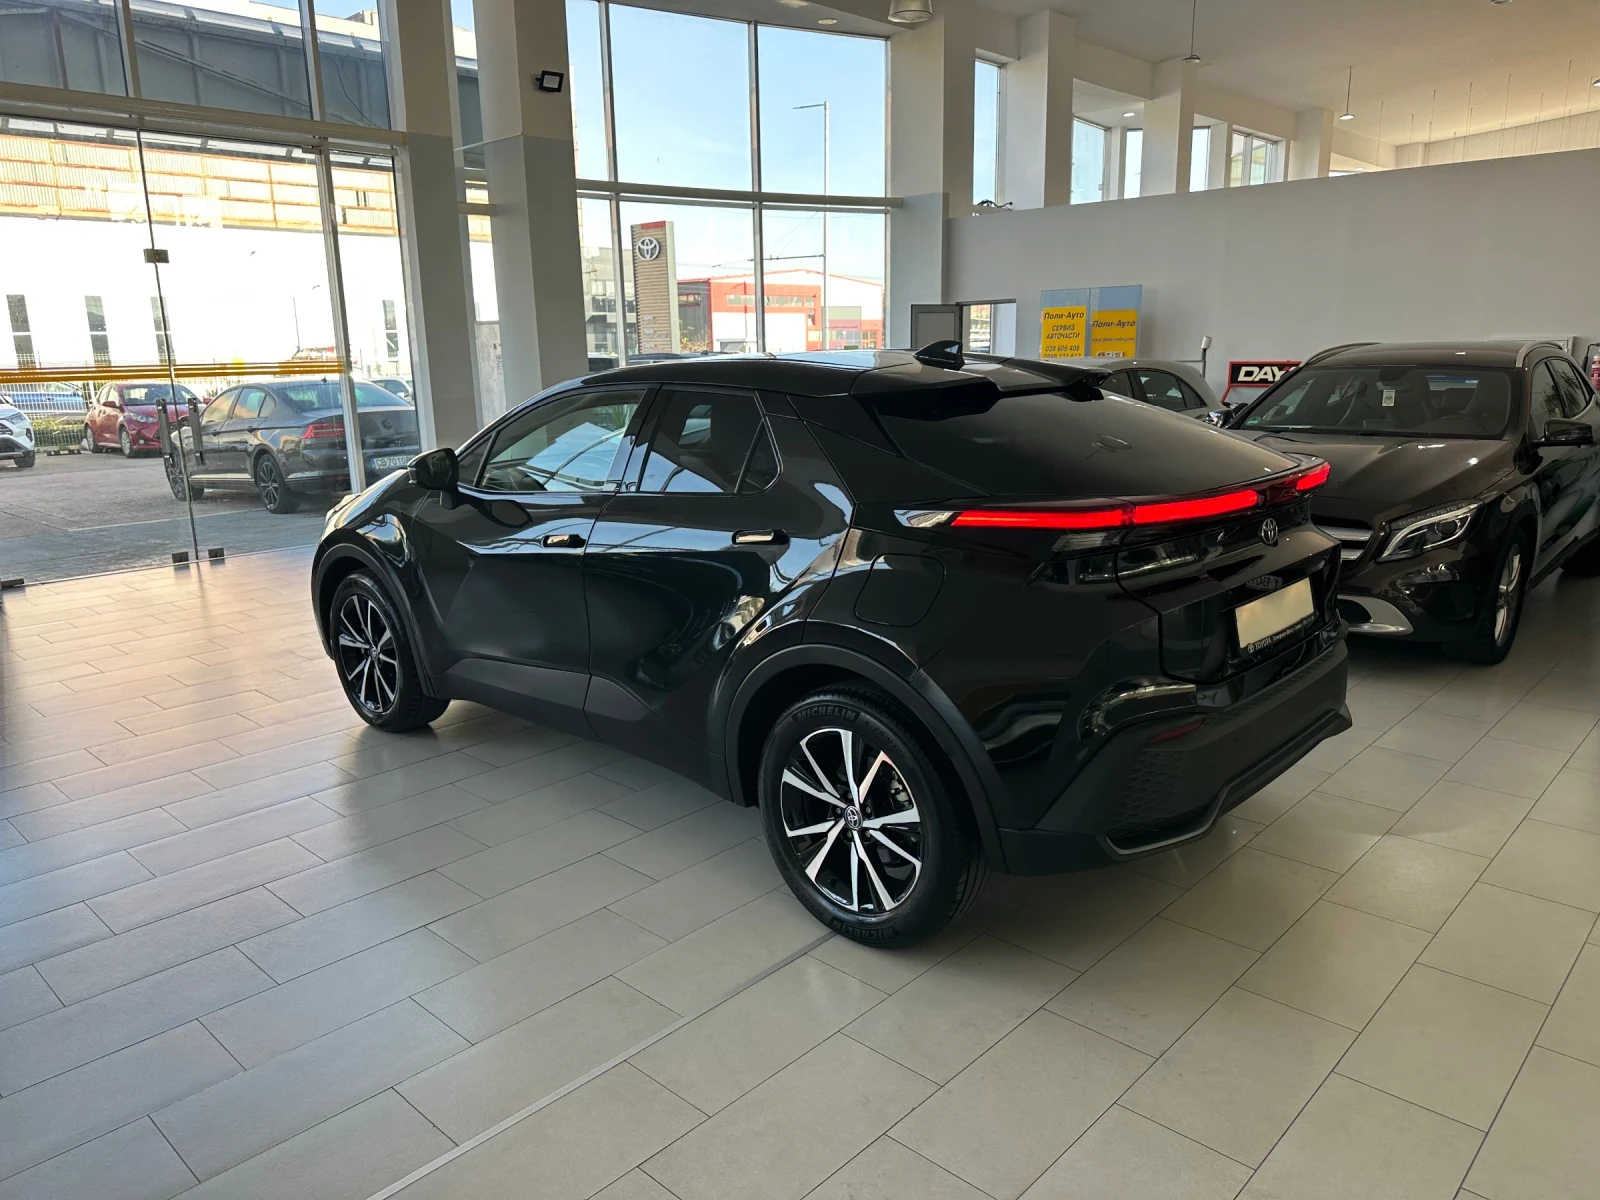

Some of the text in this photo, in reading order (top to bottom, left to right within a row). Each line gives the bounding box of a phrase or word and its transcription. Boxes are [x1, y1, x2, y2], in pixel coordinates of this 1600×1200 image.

[1044, 312, 1085, 320] Поли-Ауто
[1051, 324, 1075, 332] СЕРВИЗ
[1092, 320, 1136, 328] Поли-Ауто
[1046, 332, 1080, 340] АВТОЧАСТИ
[1238, 366, 1297, 382] DAY
[1255, 637, 1272, 649] TOYOTA
[796, 705, 858, 720] MICHELIN
